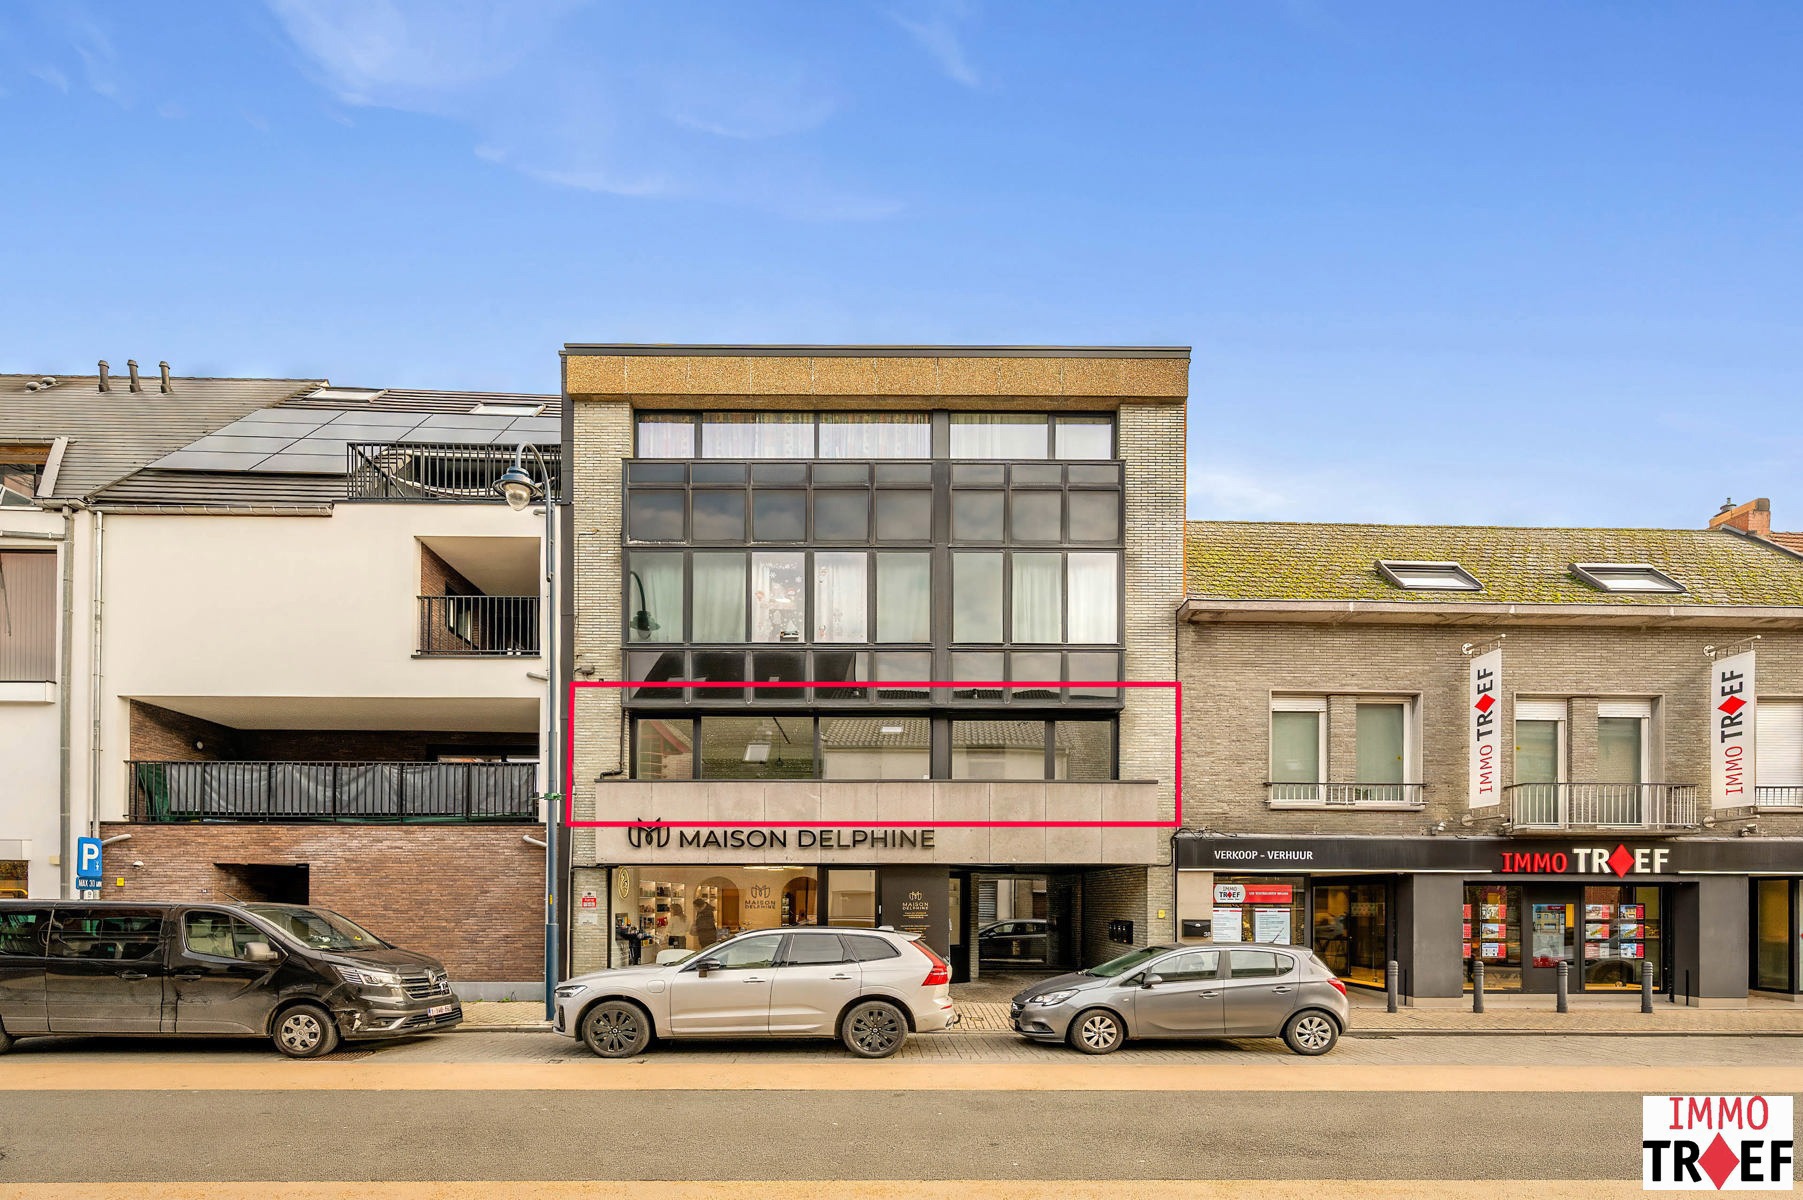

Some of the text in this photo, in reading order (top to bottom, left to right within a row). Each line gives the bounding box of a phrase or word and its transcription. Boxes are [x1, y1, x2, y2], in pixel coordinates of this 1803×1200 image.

[1479, 744, 1493, 793] IMMO
[1725, 745, 1744, 795] IMMO
[679, 829, 935, 850] MAISON DELPHINE
[82, 843, 99, 871] P
[1214, 850, 1258, 860] VERKOOP
[1267, 850, 1313, 860] VERHUUR
[1501, 852, 1567, 873] IMMO
[78, 879, 88, 887] MAX
[88, 879, 95, 887] 30
